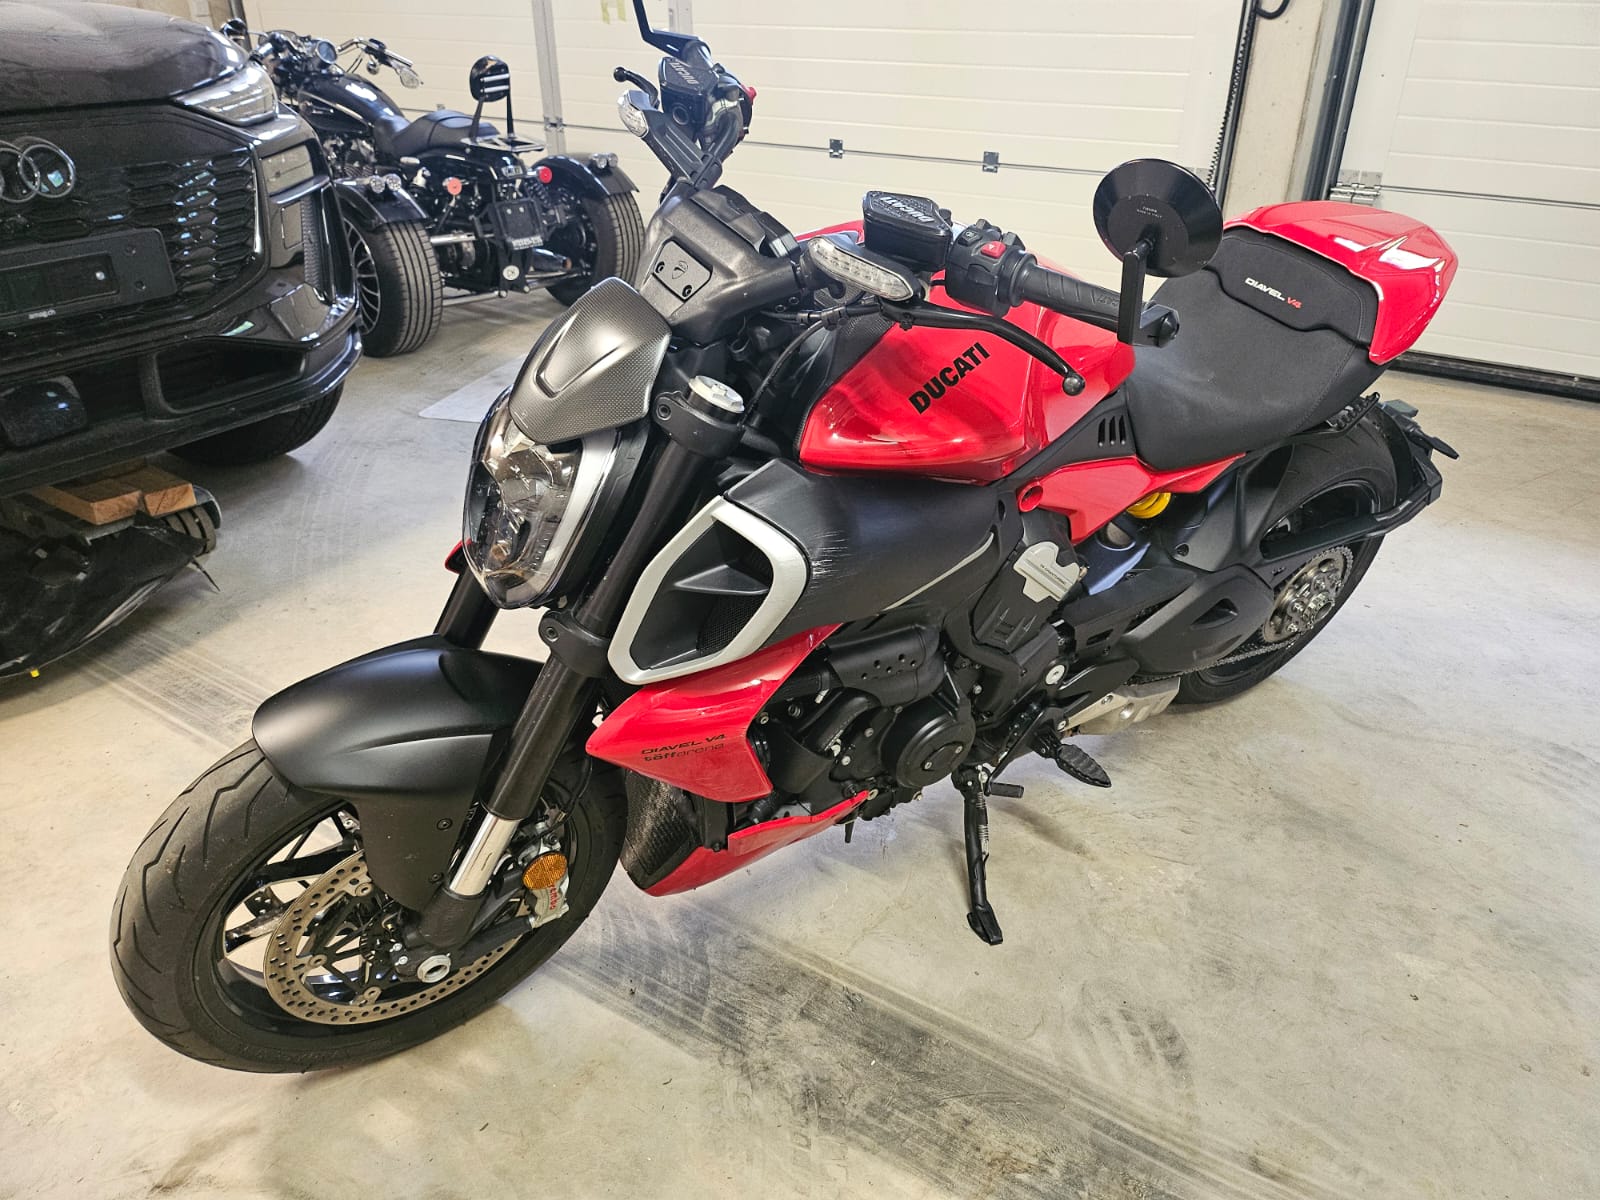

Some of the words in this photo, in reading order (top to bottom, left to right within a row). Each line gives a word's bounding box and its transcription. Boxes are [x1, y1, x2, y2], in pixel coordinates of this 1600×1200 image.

[880, 196, 935, 223] DUCATI
[1245, 277, 1285, 301] DIAVEL
[1287, 297, 1302, 309] V4
[908, 341, 991, 415] DUCATI
[641, 740, 703, 755] DIAVEL
[705, 733, 725, 743] V4
